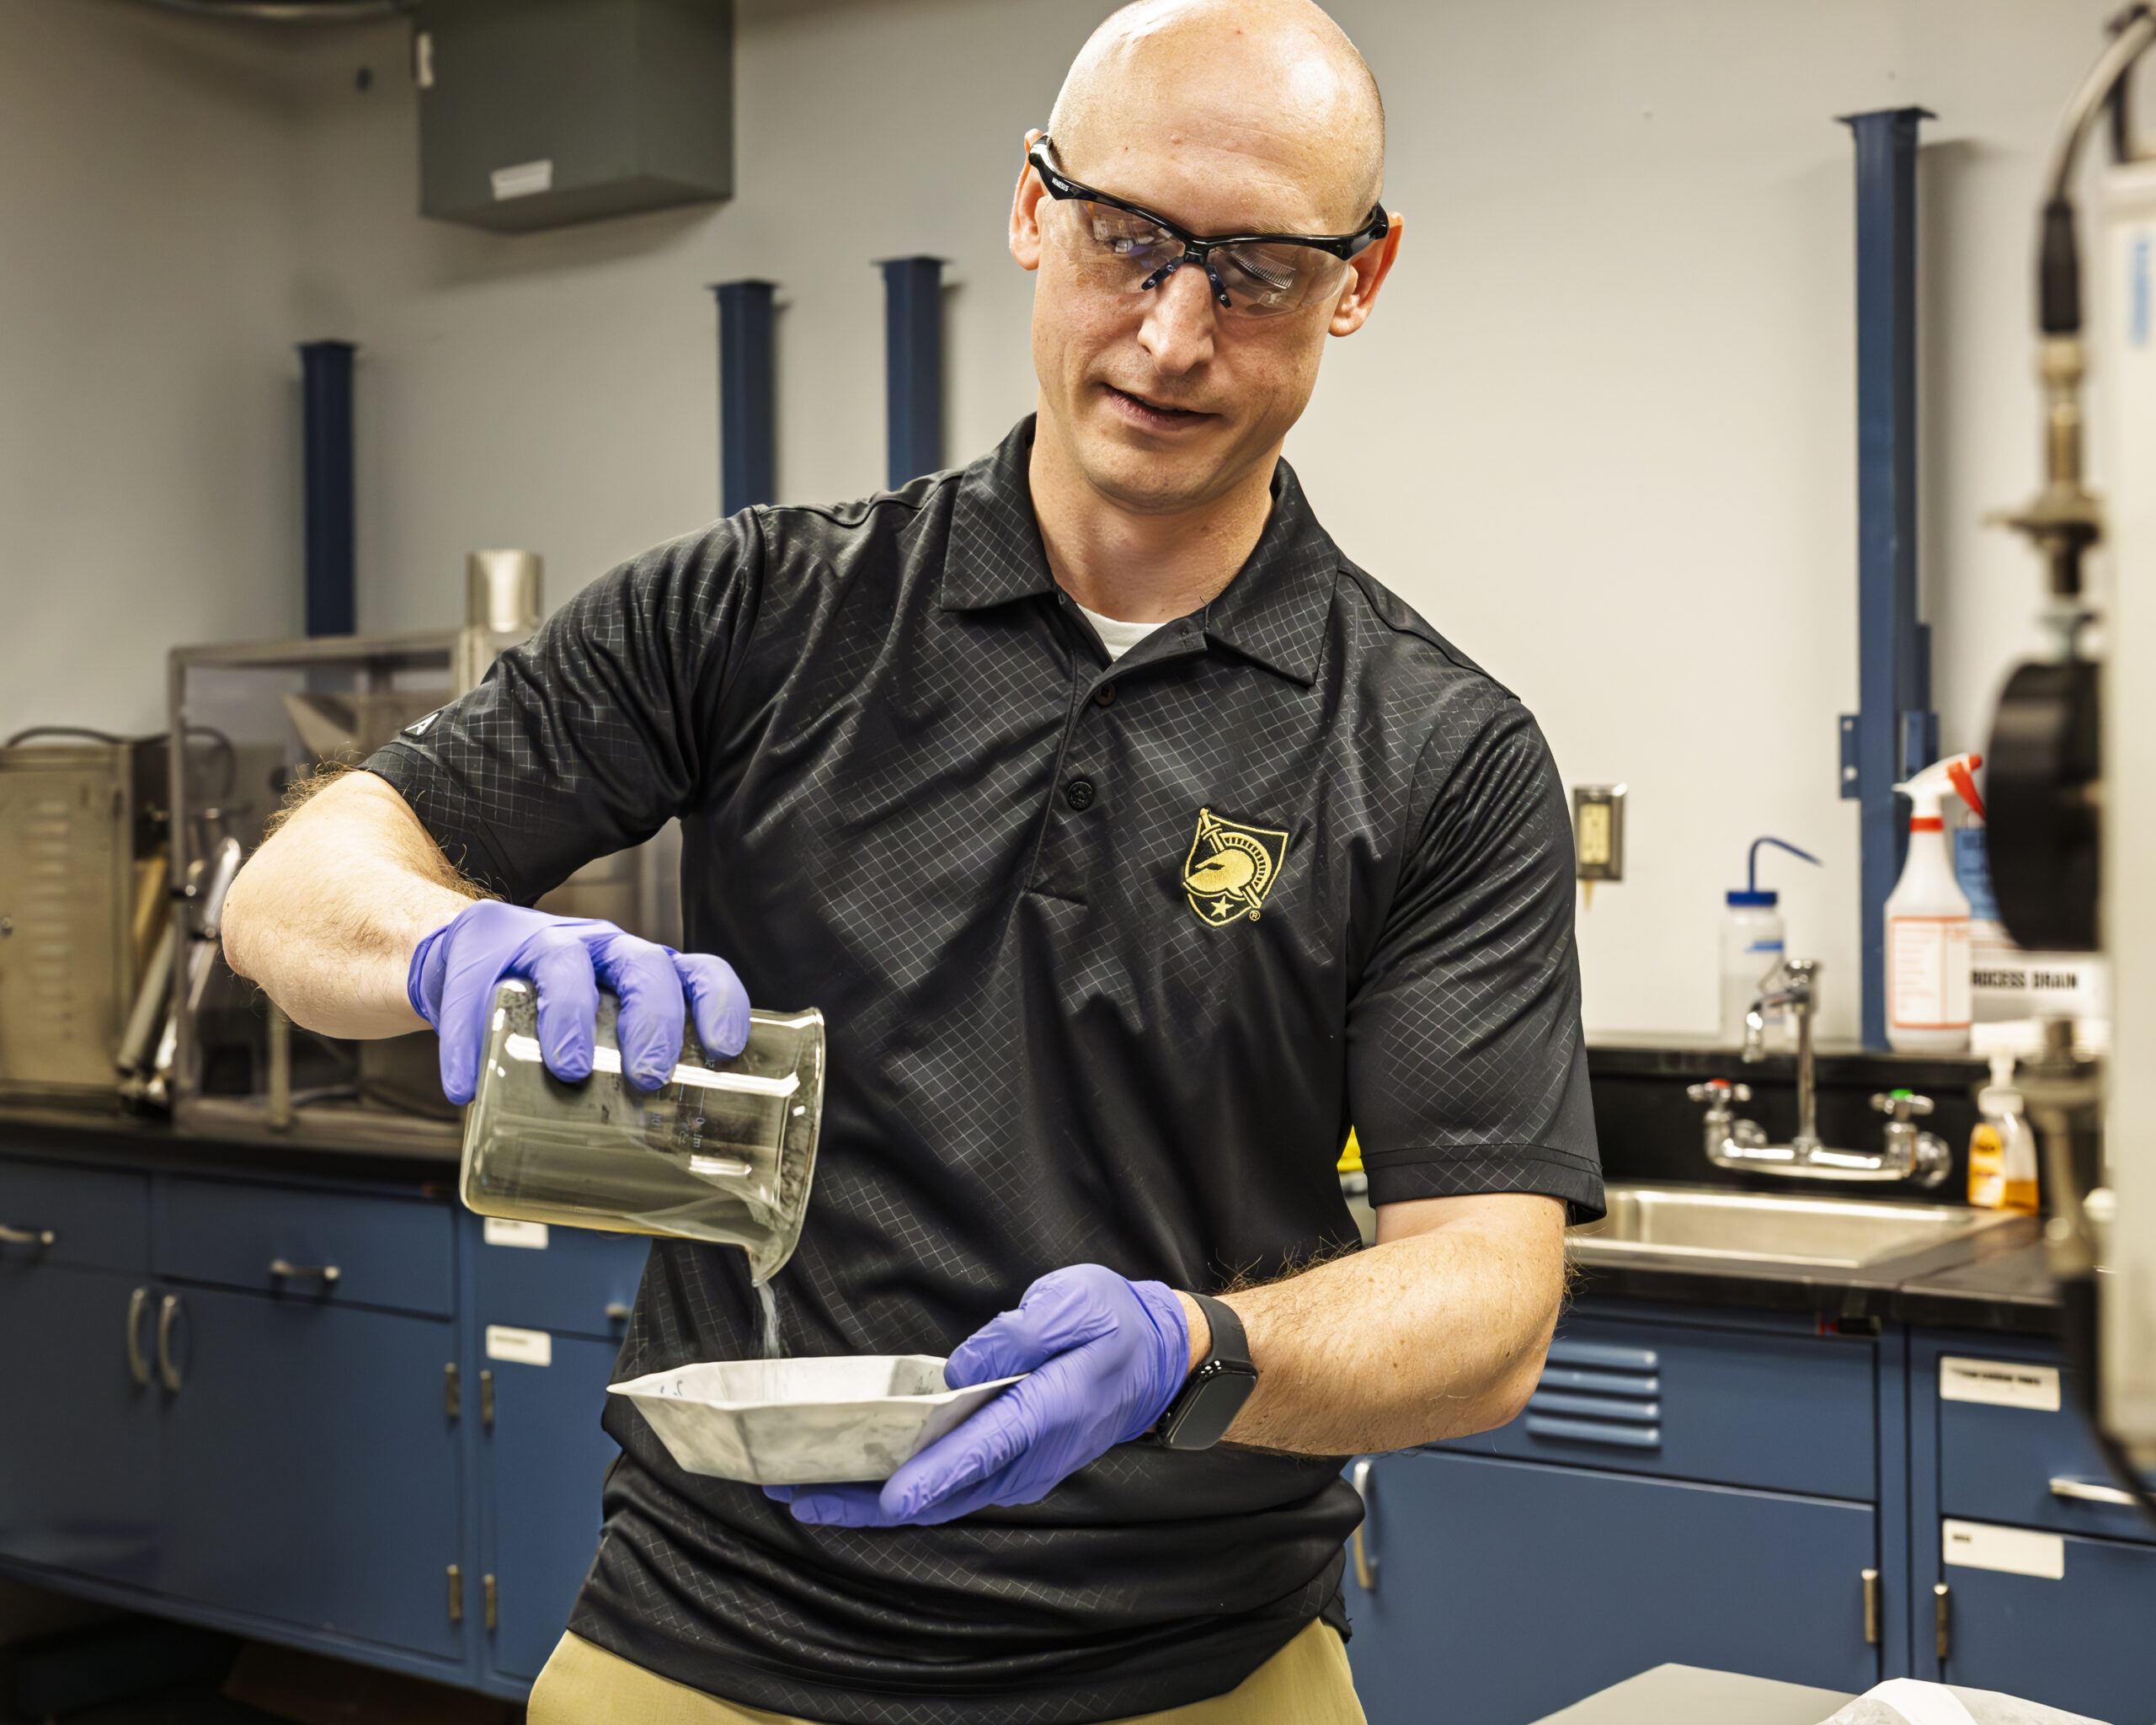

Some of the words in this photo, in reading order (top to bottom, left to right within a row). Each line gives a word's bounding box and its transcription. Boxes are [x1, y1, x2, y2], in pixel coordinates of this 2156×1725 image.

[1051, 176, 1070, 192] NEMESIS
[1971, 969, 2025, 988] ROCESS
[2033, 970, 2078, 990] DRAIN
